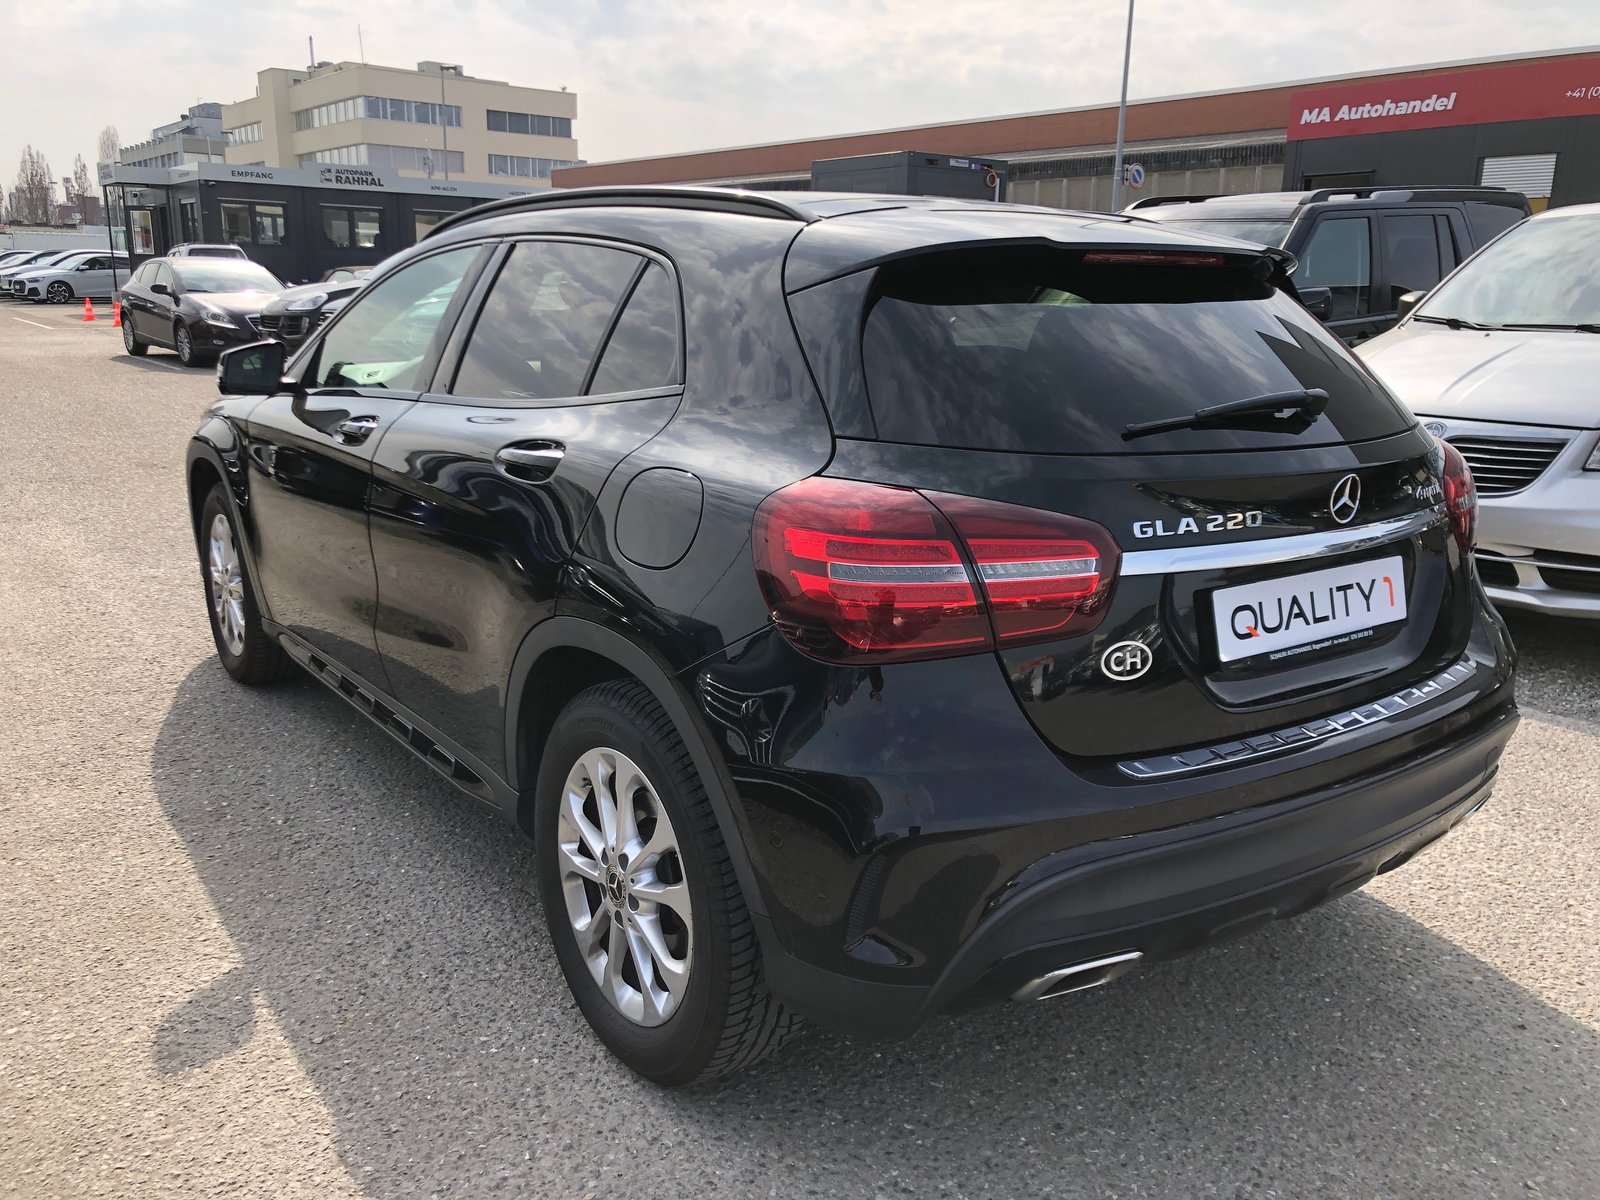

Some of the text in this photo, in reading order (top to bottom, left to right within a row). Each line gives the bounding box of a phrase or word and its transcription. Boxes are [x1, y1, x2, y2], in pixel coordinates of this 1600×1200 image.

[1565, 87, 1586, 98] +41
[1300, 92, 1457, 125] MA Autohandel
[231, 170, 274, 180] EMPFANG
[335, 168, 374, 177] AUTOPARK
[335, 175, 385, 187] RAHHAL
[1132, 510, 1263, 538] GLA 220
[1110, 650, 1142, 672] CH
